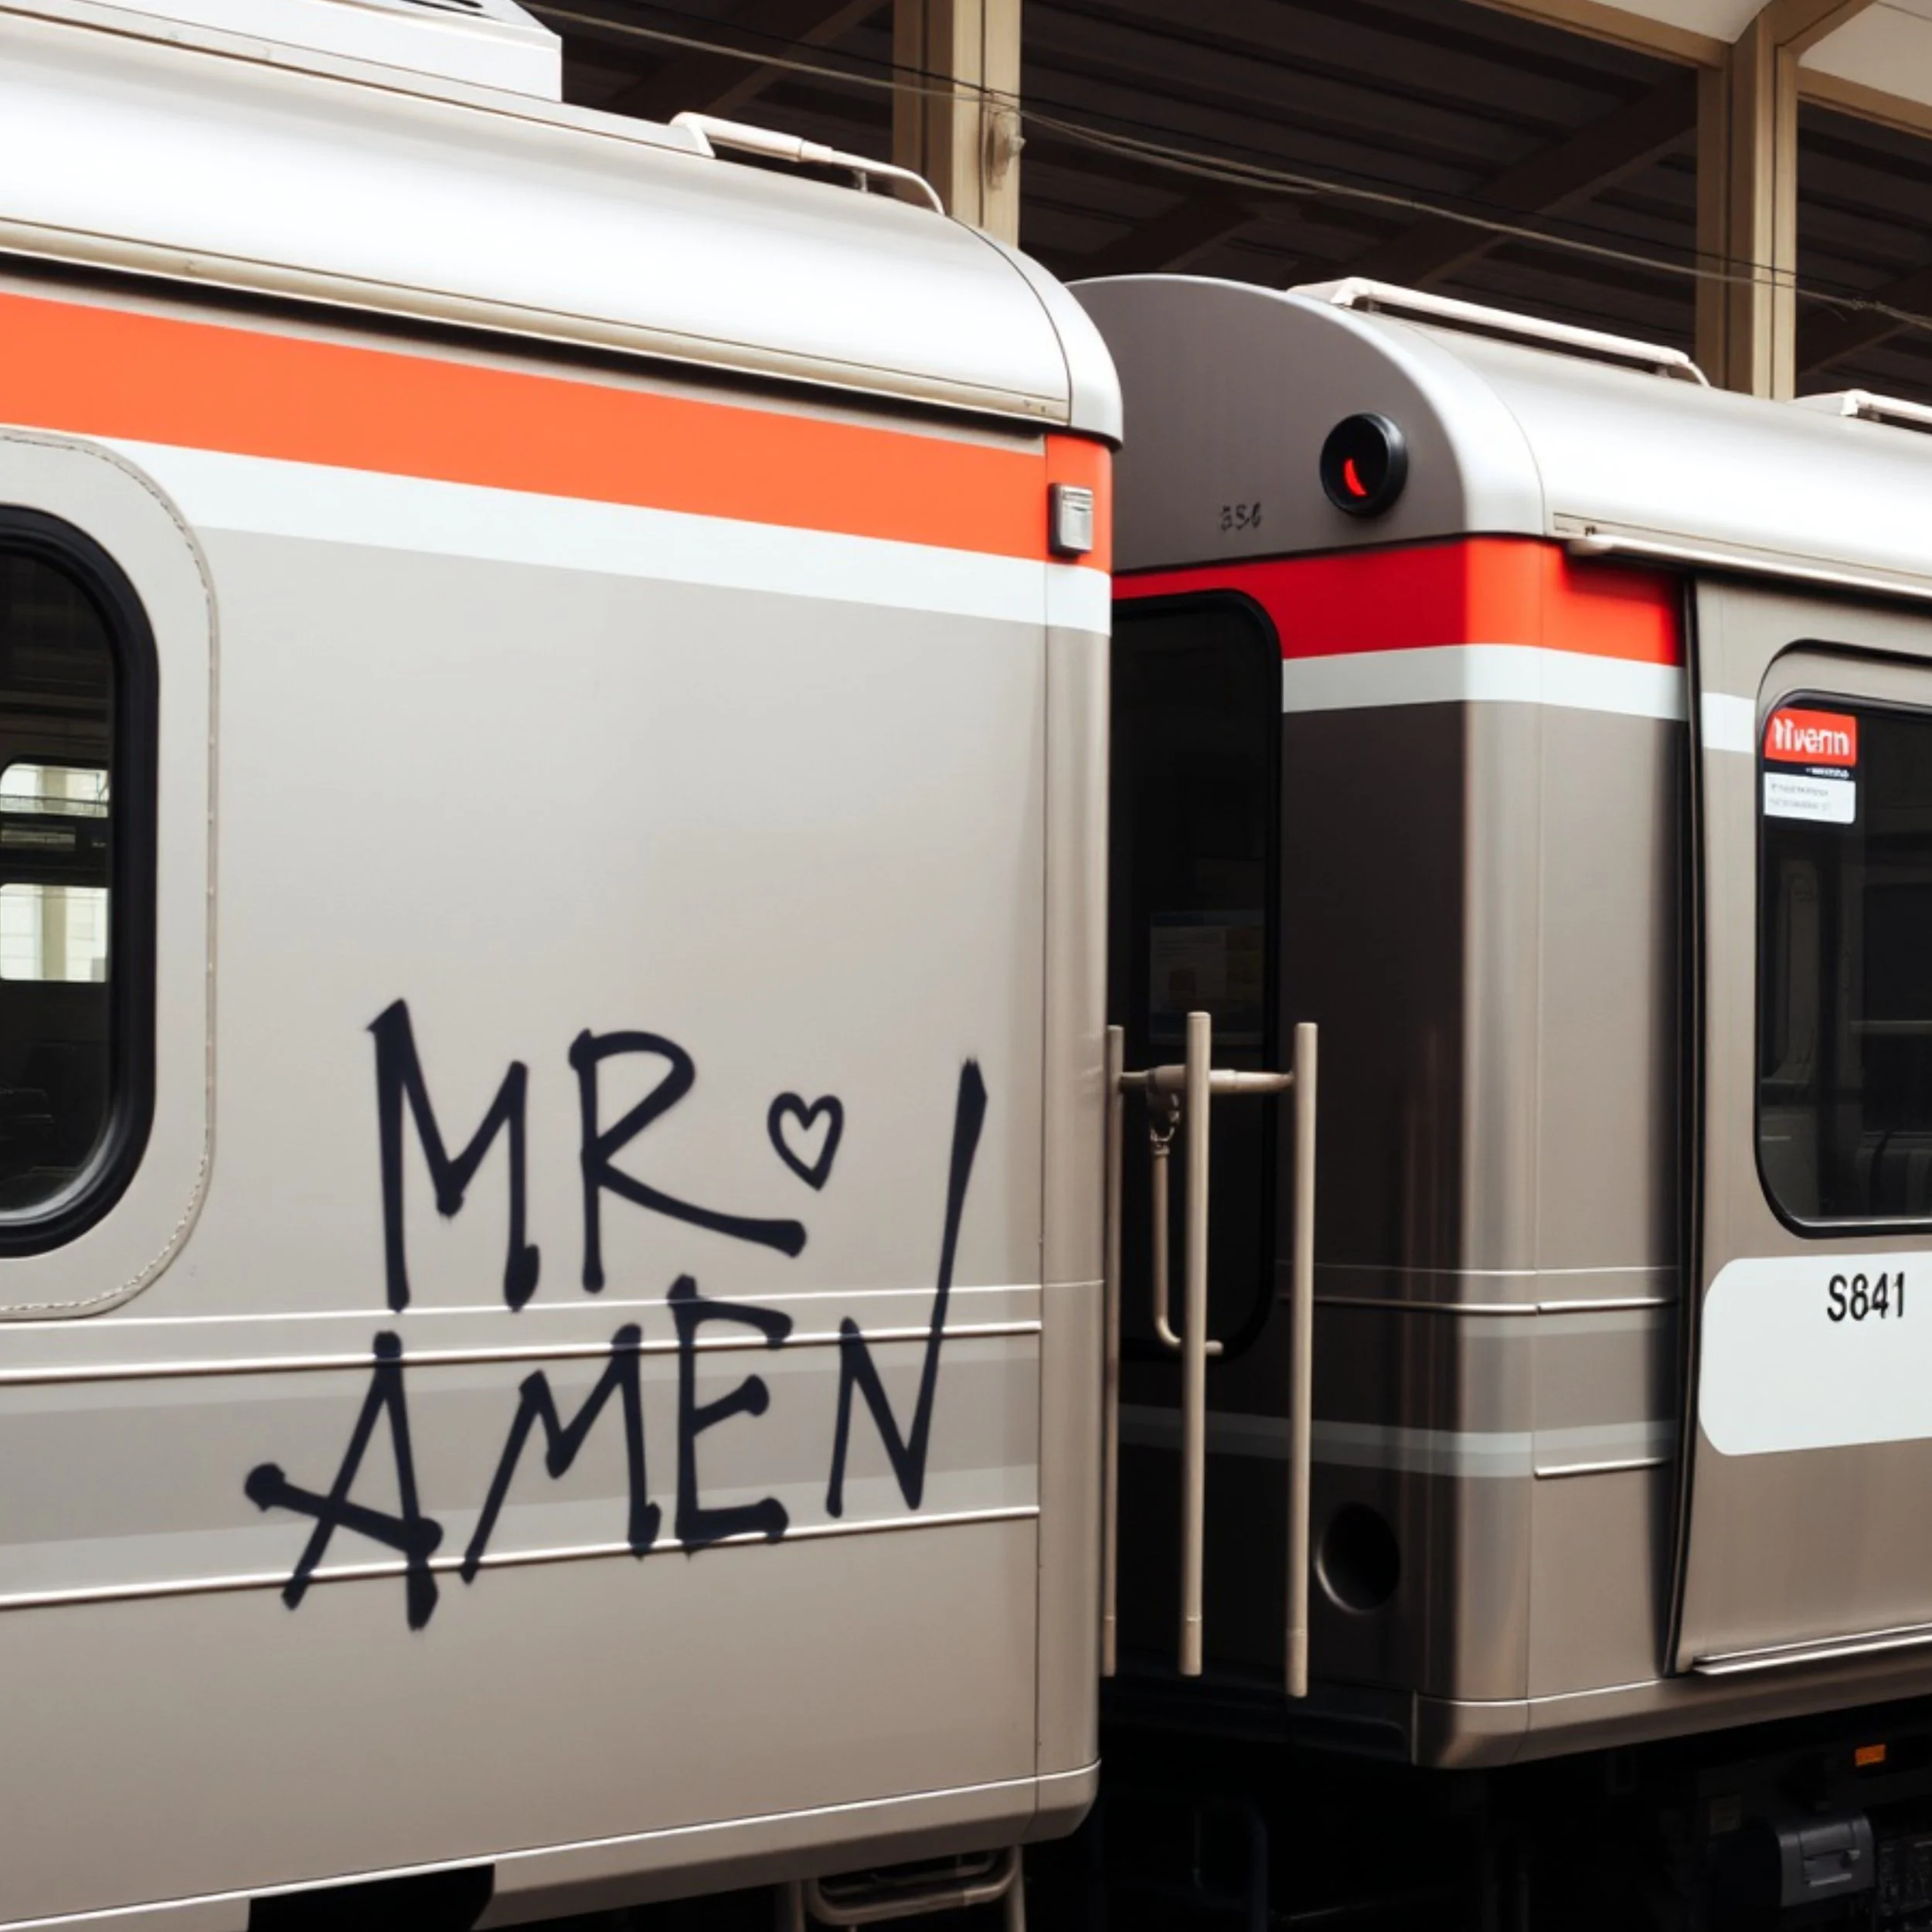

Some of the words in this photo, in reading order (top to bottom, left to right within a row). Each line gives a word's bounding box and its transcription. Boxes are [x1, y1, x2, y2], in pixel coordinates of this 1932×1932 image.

[367, 998, 807, 1313] MR
[1827, 1271, 1905, 1322] S841
[244, 1056, 988, 1631] AMEN
